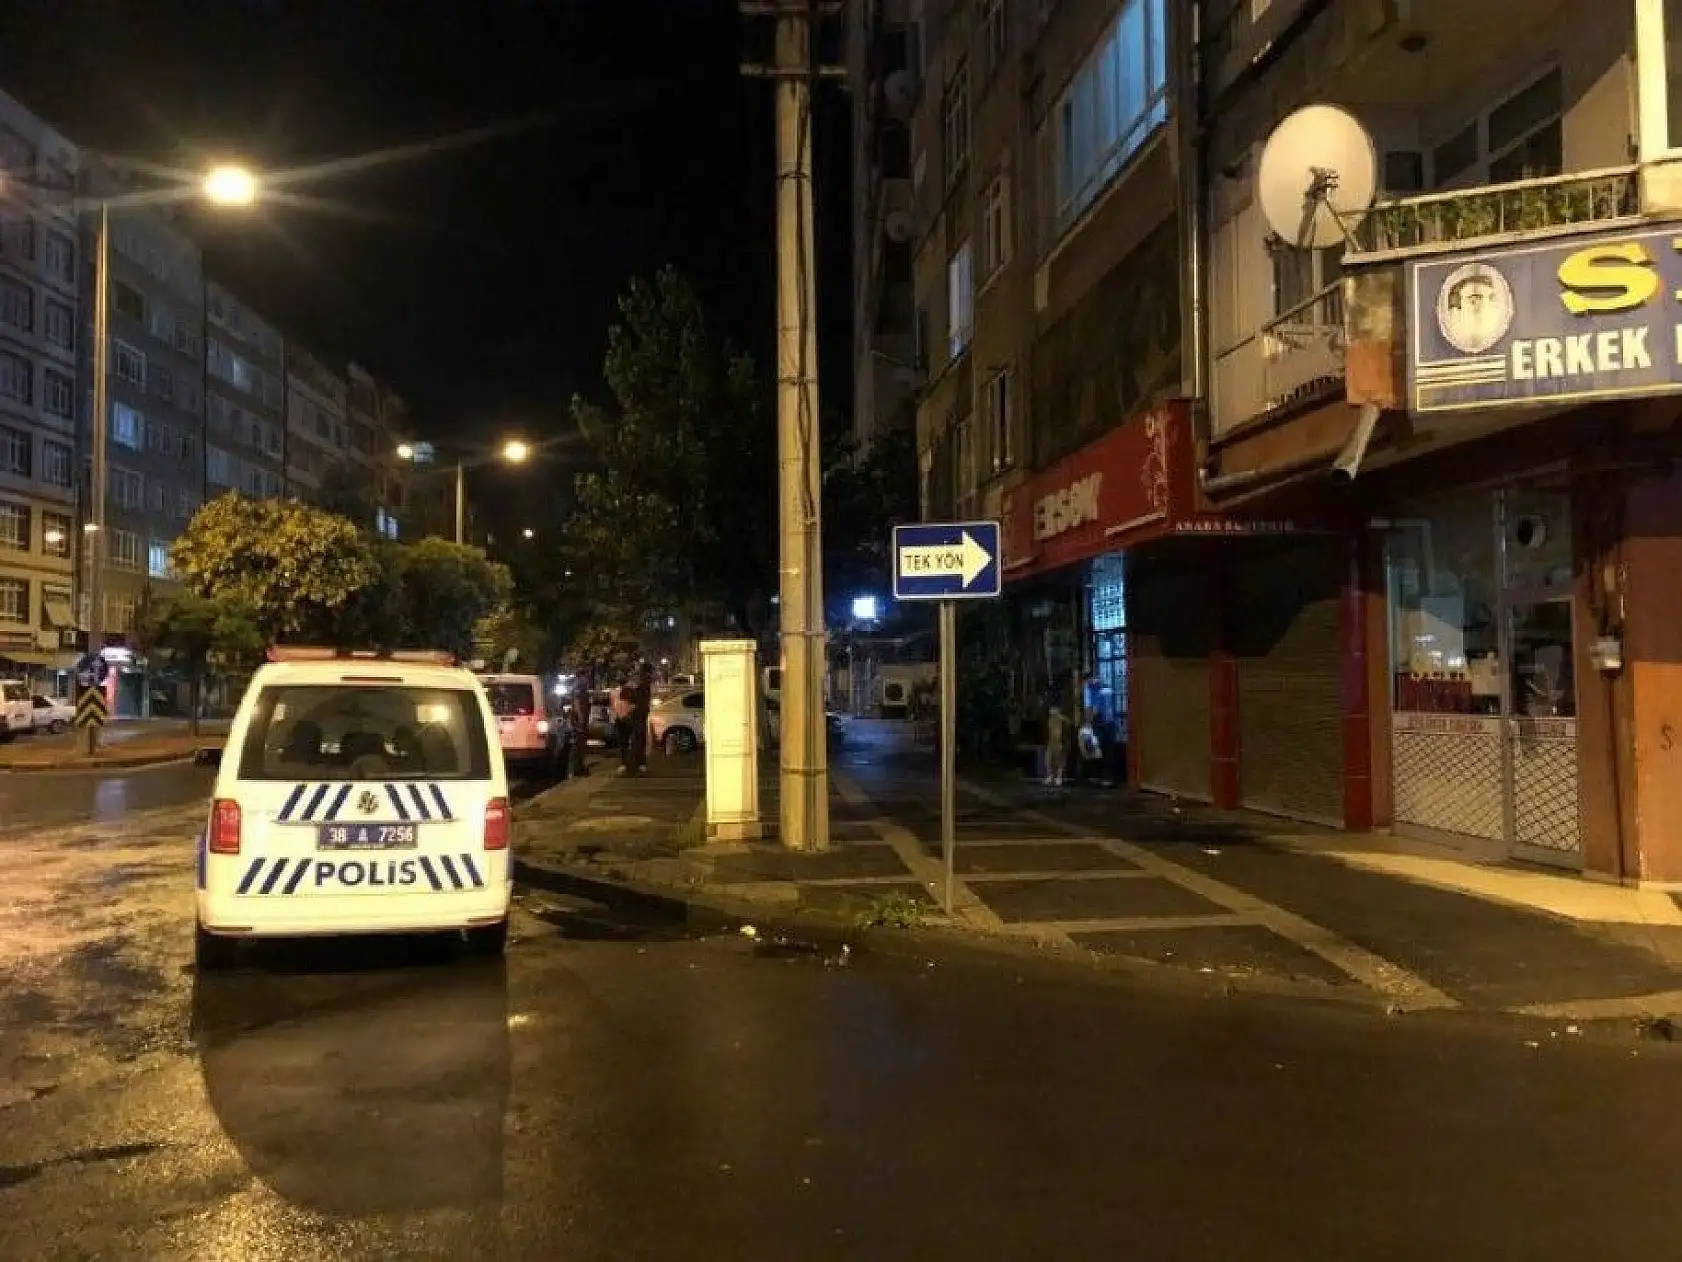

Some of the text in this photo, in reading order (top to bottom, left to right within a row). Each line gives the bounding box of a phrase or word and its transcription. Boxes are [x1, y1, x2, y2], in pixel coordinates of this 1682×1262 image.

[1558, 238, 1682, 315] S
[1512, 325, 1652, 380] ERKEK
[904, 550, 963, 571] TEK YÖN
[329, 826, 347, 842] 38
[358, 826, 369, 842] A
